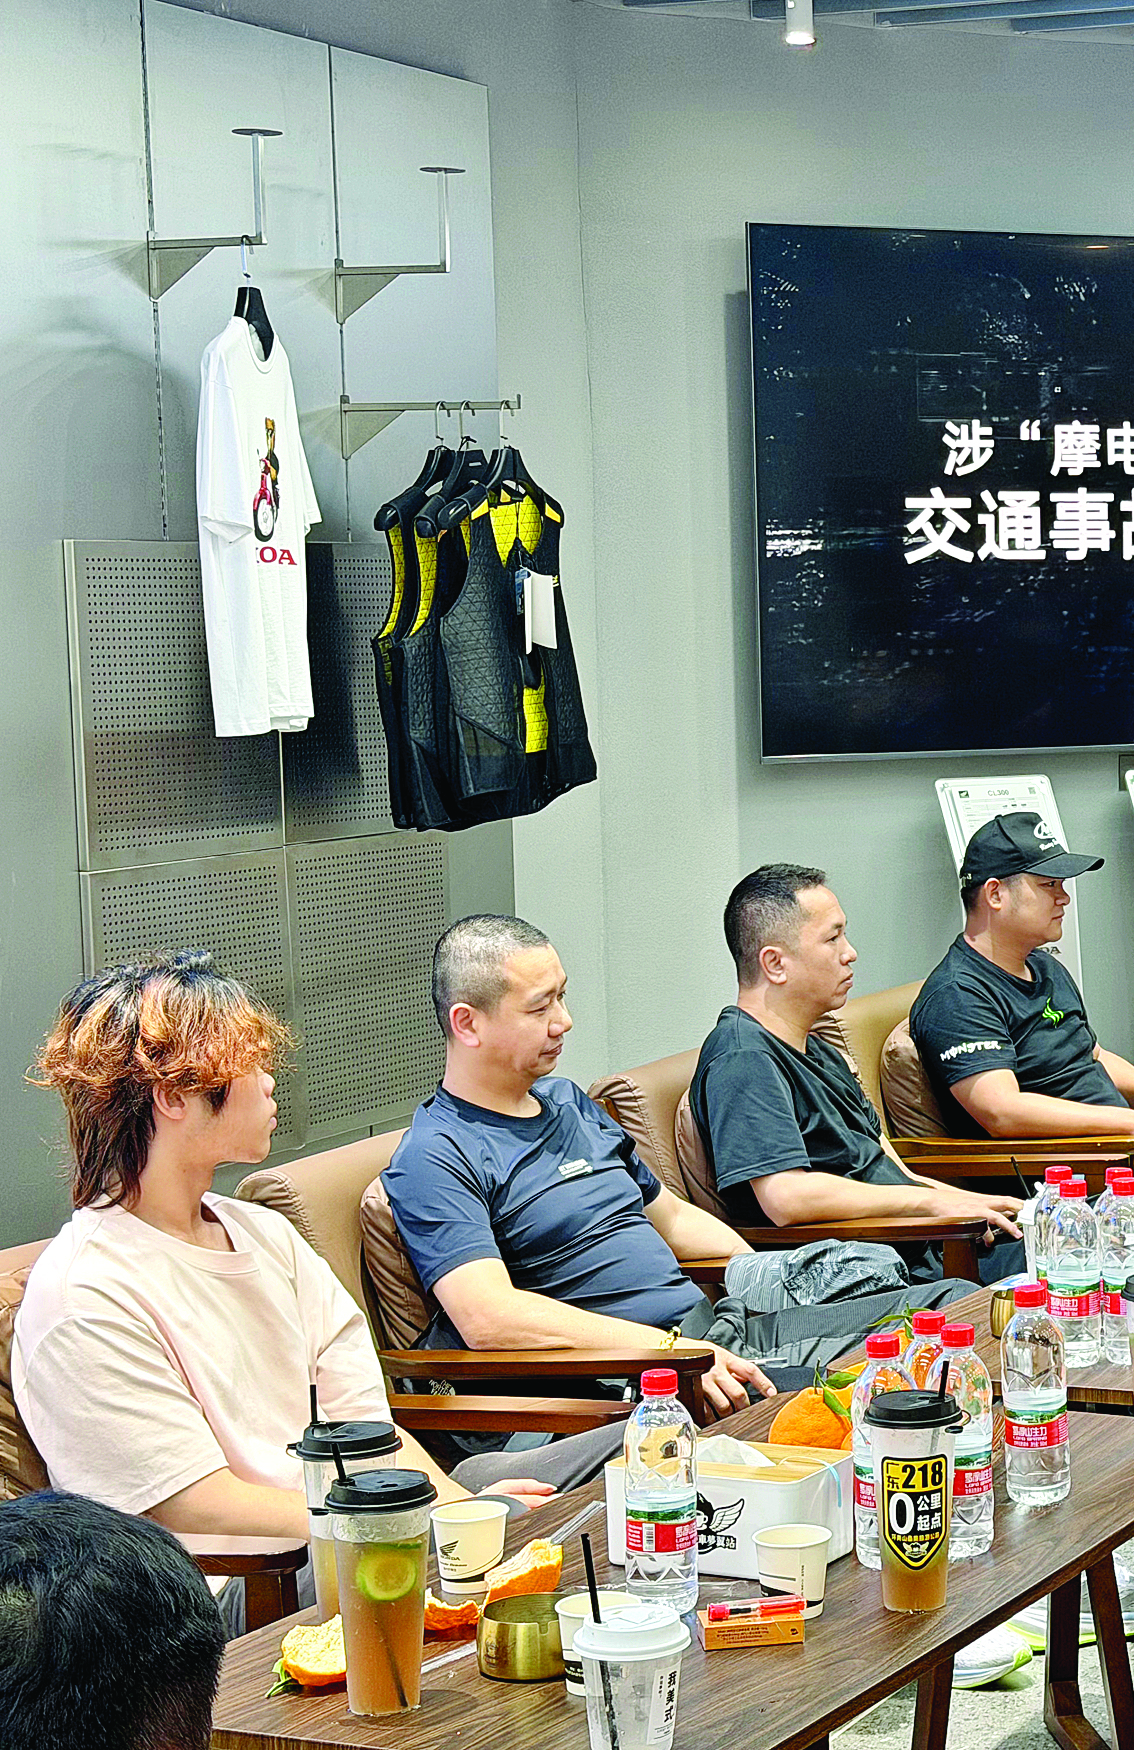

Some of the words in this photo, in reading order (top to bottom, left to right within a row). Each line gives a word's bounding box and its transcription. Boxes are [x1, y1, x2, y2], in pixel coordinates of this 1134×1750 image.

[886, 1462, 900, 1490] 广东
[902, 1460, 943, 1489] 218
[889, 1492, 915, 1535] 0
[916, 1492, 942, 1512] 公里
[916, 1512, 942, 1532] 起点
